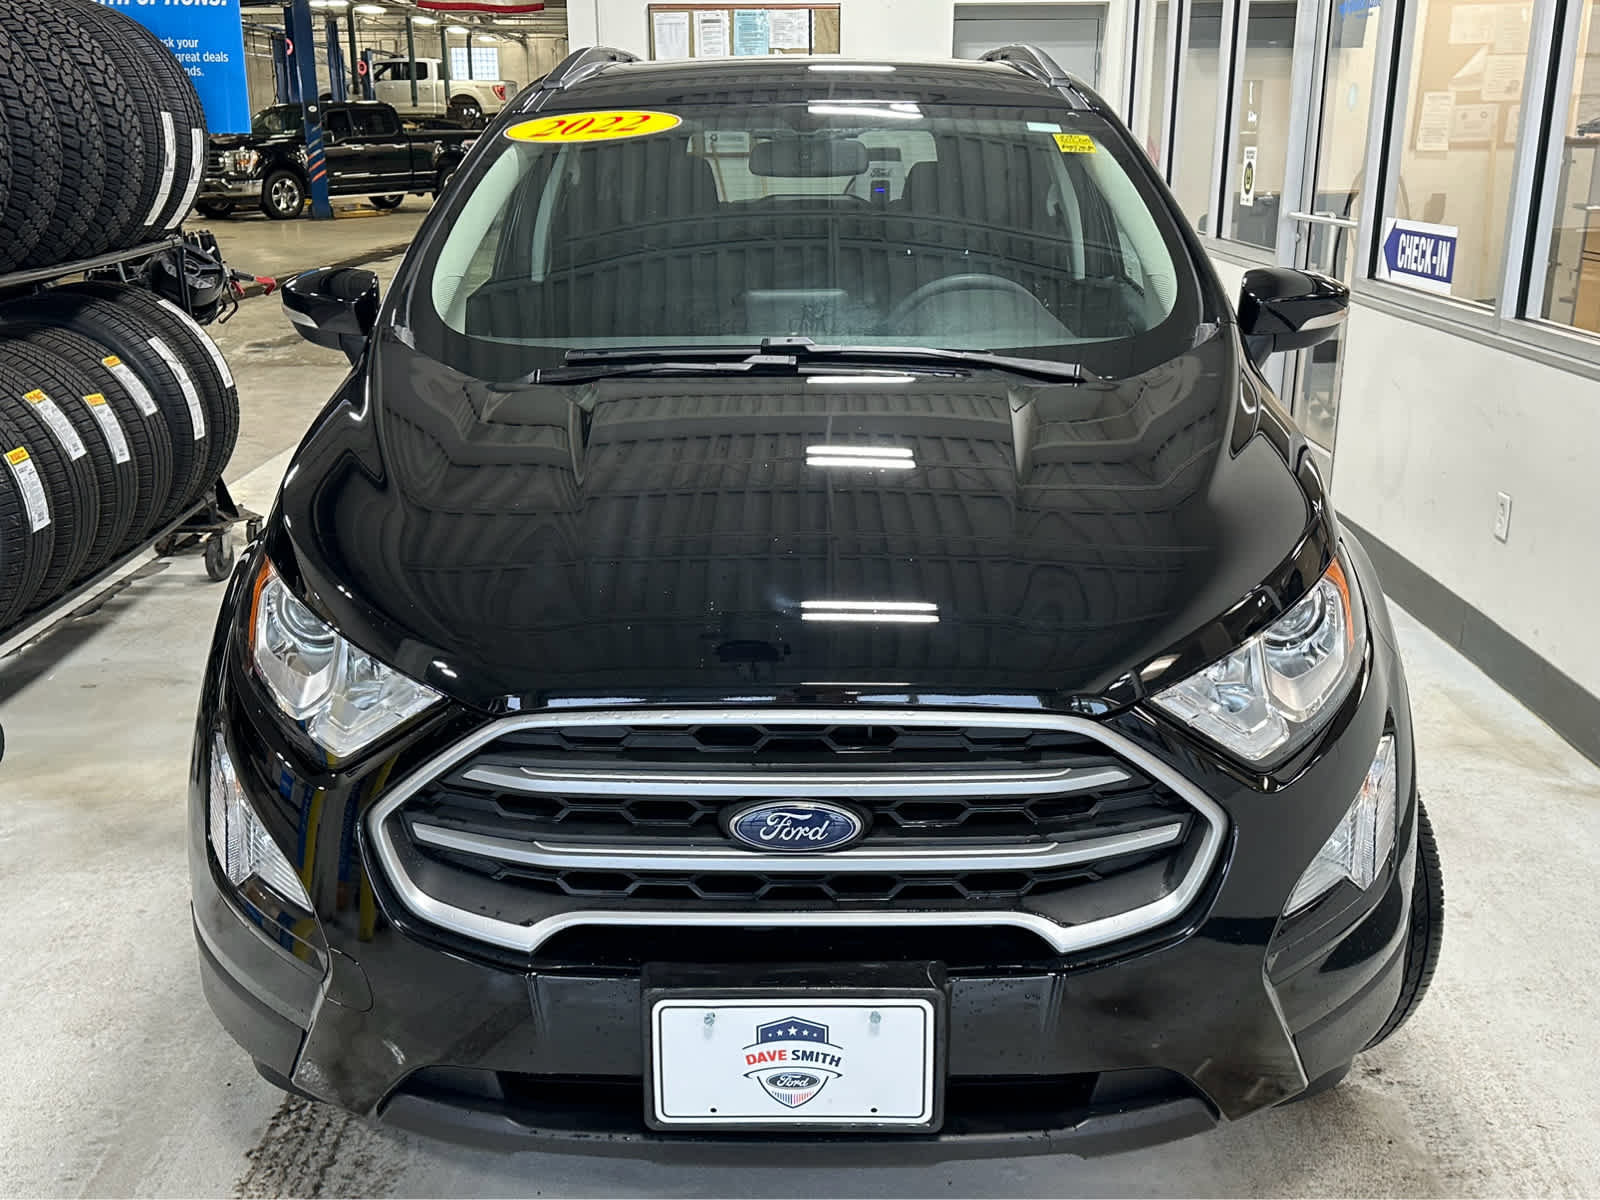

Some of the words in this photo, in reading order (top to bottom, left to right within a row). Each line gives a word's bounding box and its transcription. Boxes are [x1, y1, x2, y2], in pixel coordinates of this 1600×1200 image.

[176, 39, 199, 50] your
[202, 50, 229, 62] deals
[529, 114, 652, 138] 2022
[1397, 232, 1451, 278] CHECK-IN
[759, 811, 831, 841] Ford
[745, 1049, 787, 1066] DAVE
[791, 1049, 842, 1068] SMITH
[775, 1074, 810, 1088] Ford
